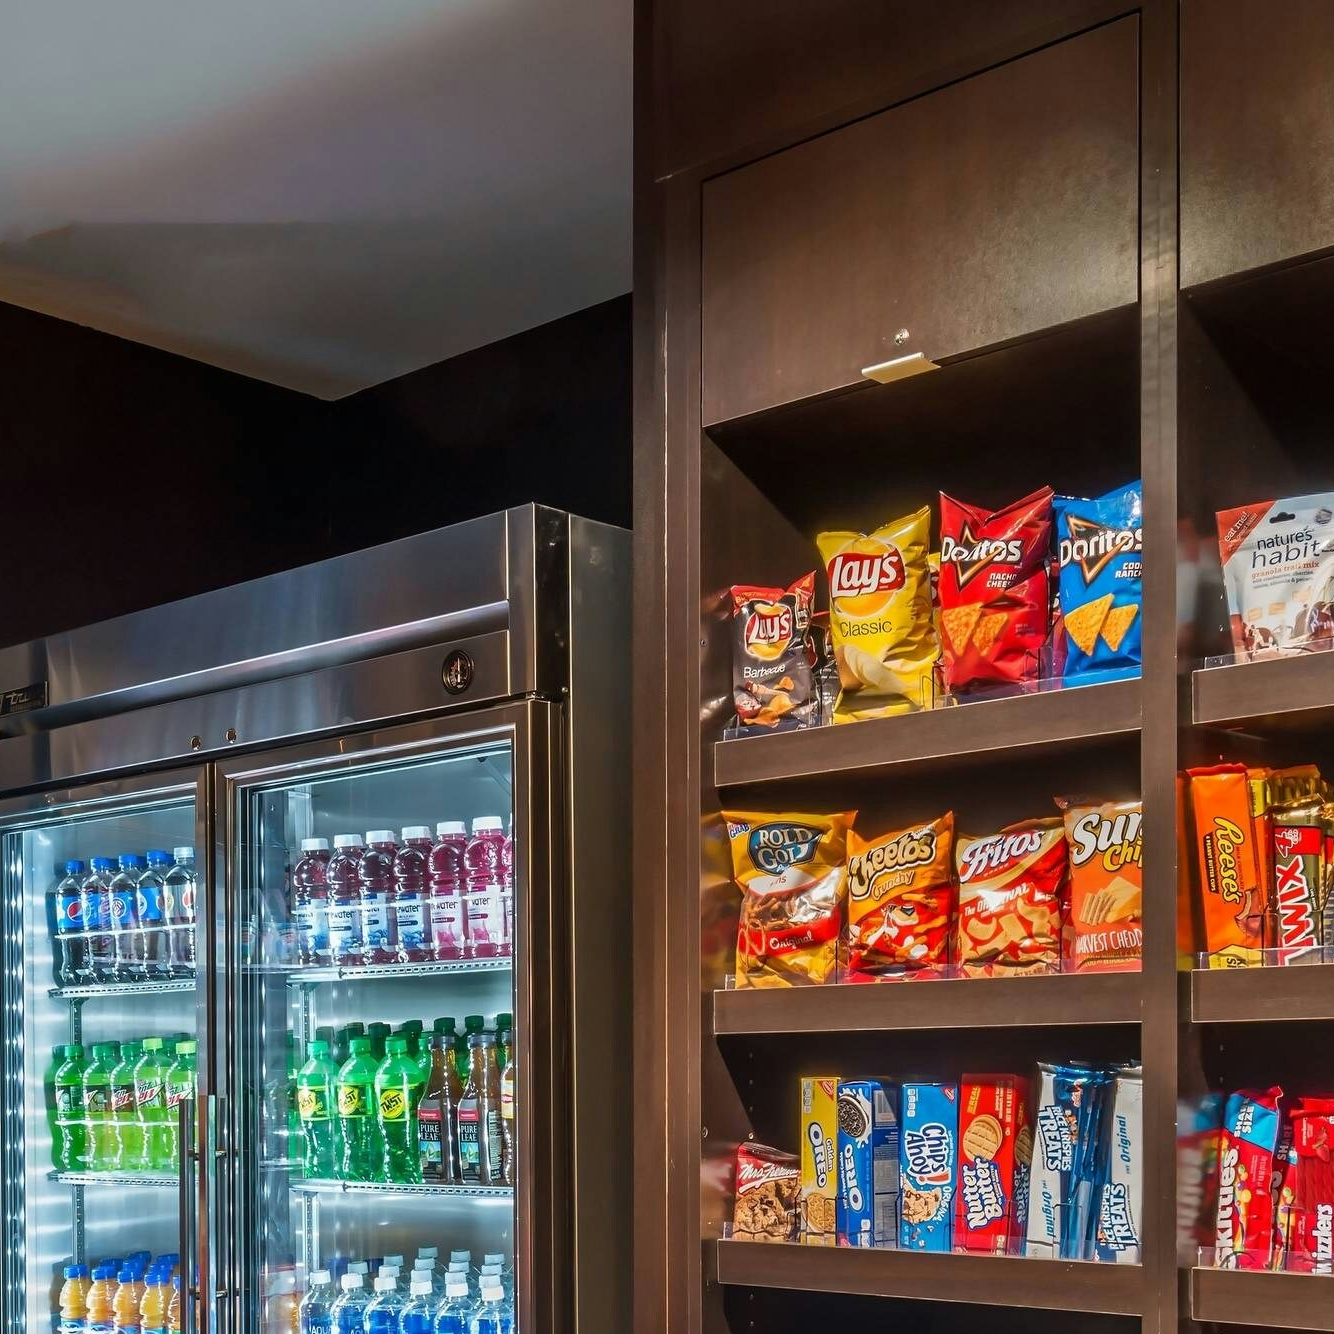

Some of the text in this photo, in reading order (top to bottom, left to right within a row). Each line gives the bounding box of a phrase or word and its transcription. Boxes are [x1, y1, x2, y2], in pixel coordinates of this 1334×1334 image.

[941, 537, 1021, 562] Doritos
[1060, 530, 1142, 567] Doritos
[1252, 541, 1320, 568] habit
[1257, 526, 1315, 550] nature's
[832, 554, 899, 597] Lay's
[840, 618, 893, 637] Classic
[758, 828, 813, 848] ROLD
[960, 831, 1046, 884] Fritos
[850, 828, 936, 899] Cheetos
[1214, 817, 1244, 904] Reese's
[873, 870, 915, 900] Crunchy
[769, 931, 814, 950] Original
[421, 1124, 439, 1133] PURE
[461, 1125, 477, 1134] PURE
[1039, 1106, 1061, 1172] TREATS
[1117, 1115, 1131, 1163] Original
[1242, 1106, 1254, 1134] SIZE
[808, 1122, 827, 1188] OREO
[825, 1138, 833, 1172] Golden
[921, 1123, 947, 1173] Chips
[844, 1143, 863, 1212] OREO
[963, 1165, 988, 1230] Nutter
[974, 1156, 1004, 1219] Butter
[1041, 1191, 1056, 1238] Original
[1112, 1183, 1138, 1251] TREATS
